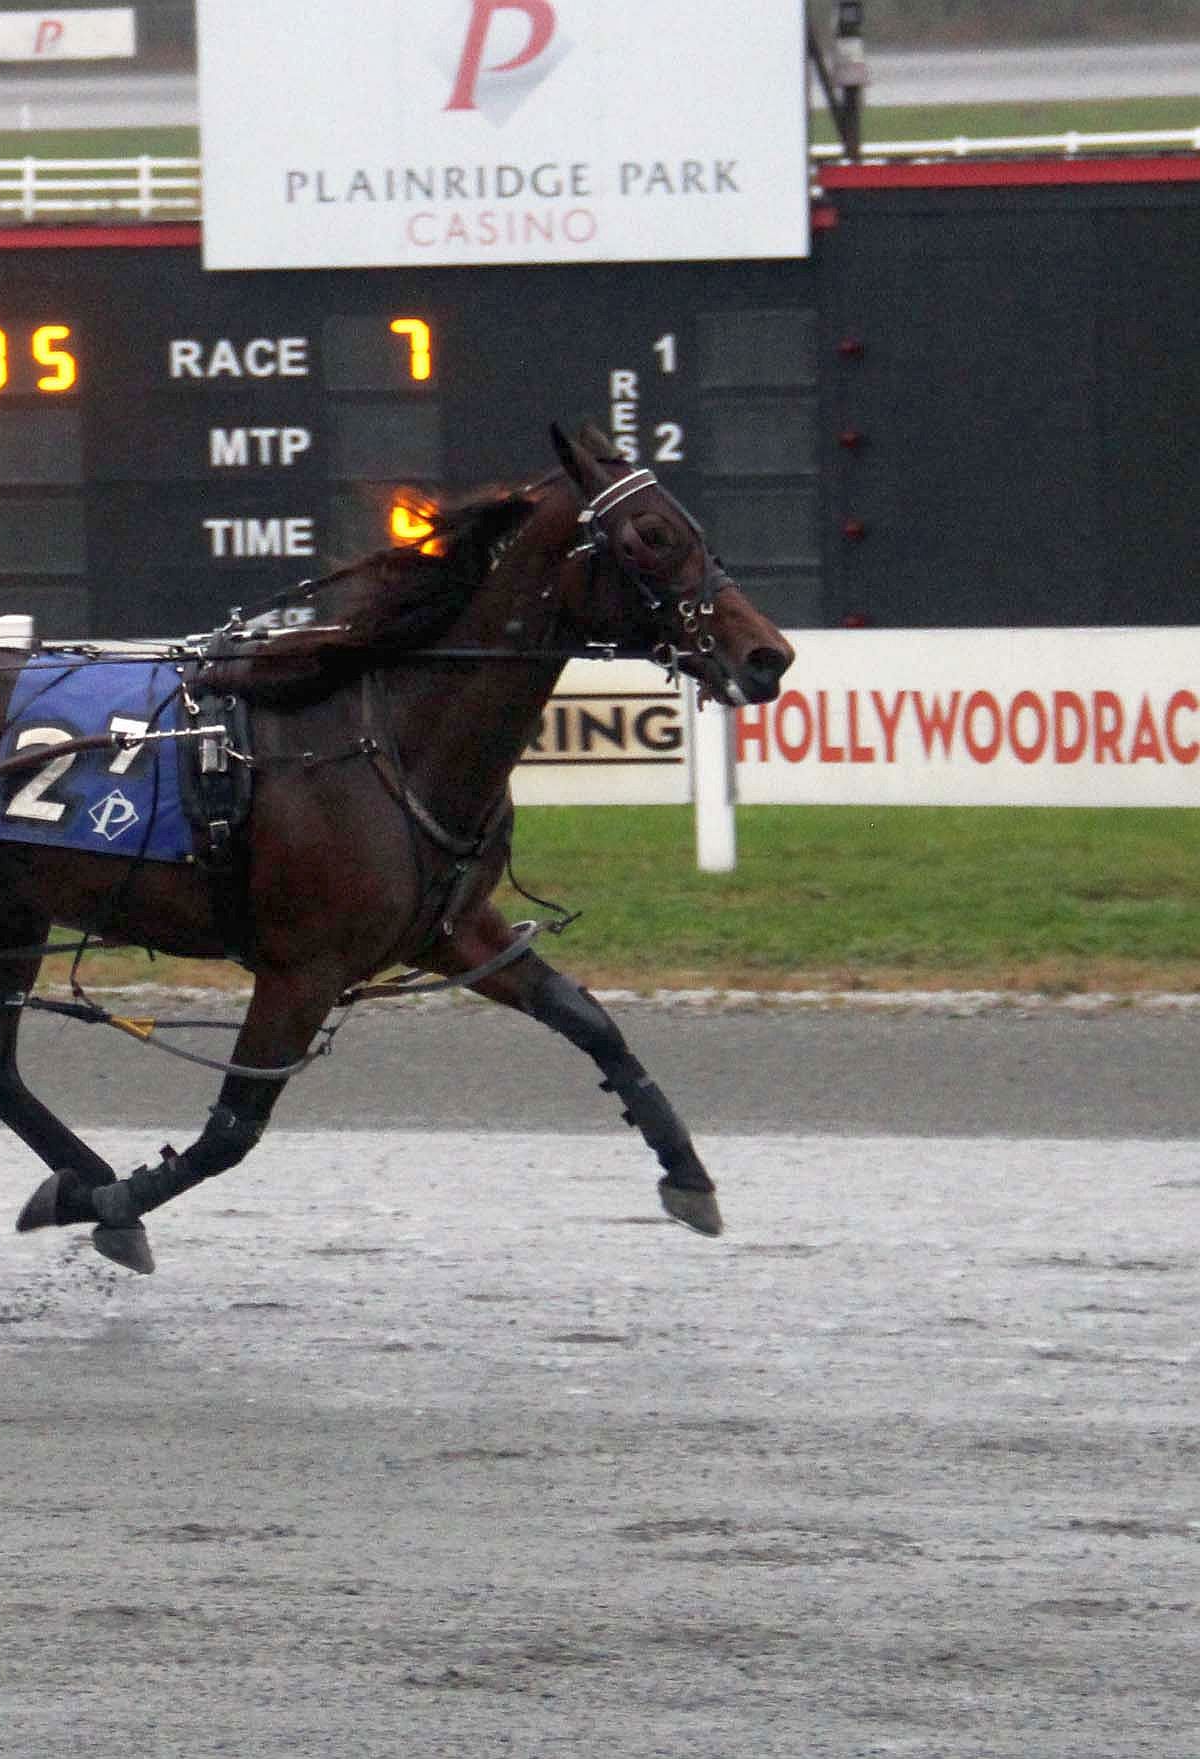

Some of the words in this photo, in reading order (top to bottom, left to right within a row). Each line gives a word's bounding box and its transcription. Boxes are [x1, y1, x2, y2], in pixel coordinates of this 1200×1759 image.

[443, 0, 557, 111] P
[286, 163, 591, 203] PLAINRIDGE
[620, 159, 740, 196] PARK
[406, 208, 597, 247] CASINO
[169, 337, 310, 378] RACE
[390, 318, 431, 380] 7
[653, 333, 675, 373] 1
[210, 427, 311, 467] MTP
[655, 422, 682, 461] 2
[203, 518, 313, 557] TIME
[109, 716, 149, 775] 7
[527, 705, 683, 752] ING
[735, 689, 1200, 765] HOLLYWOODRAC
[5, 726, 77, 822] 2
